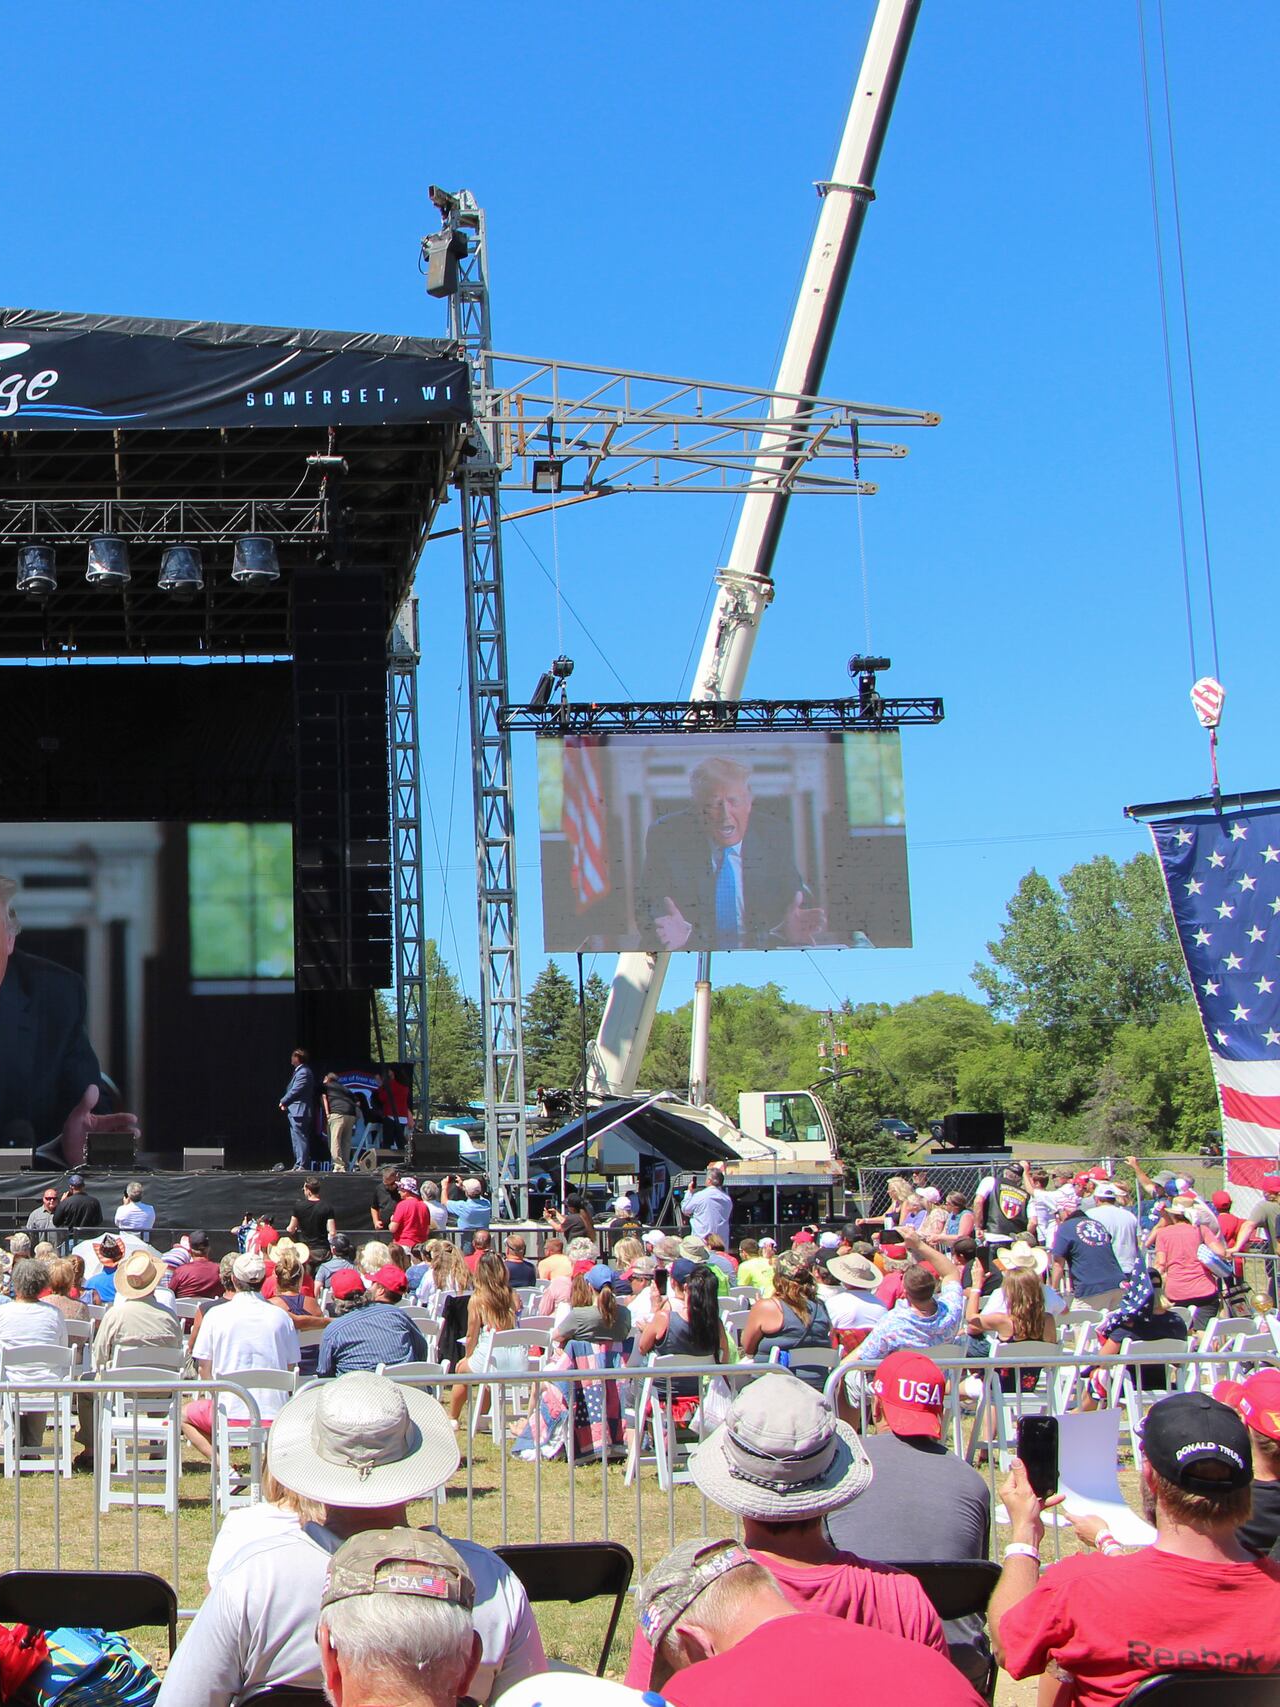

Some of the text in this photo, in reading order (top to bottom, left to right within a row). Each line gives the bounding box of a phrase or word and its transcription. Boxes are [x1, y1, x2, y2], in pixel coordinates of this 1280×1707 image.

[246, 386, 452, 407] SOMERSET, WI
[898, 1379, 941, 1405] USA
[1175, 1442, 1216, 1461] DONALD
[388, 1576, 418, 1589] USA
[1127, 1640, 1265, 1671] Reebok
